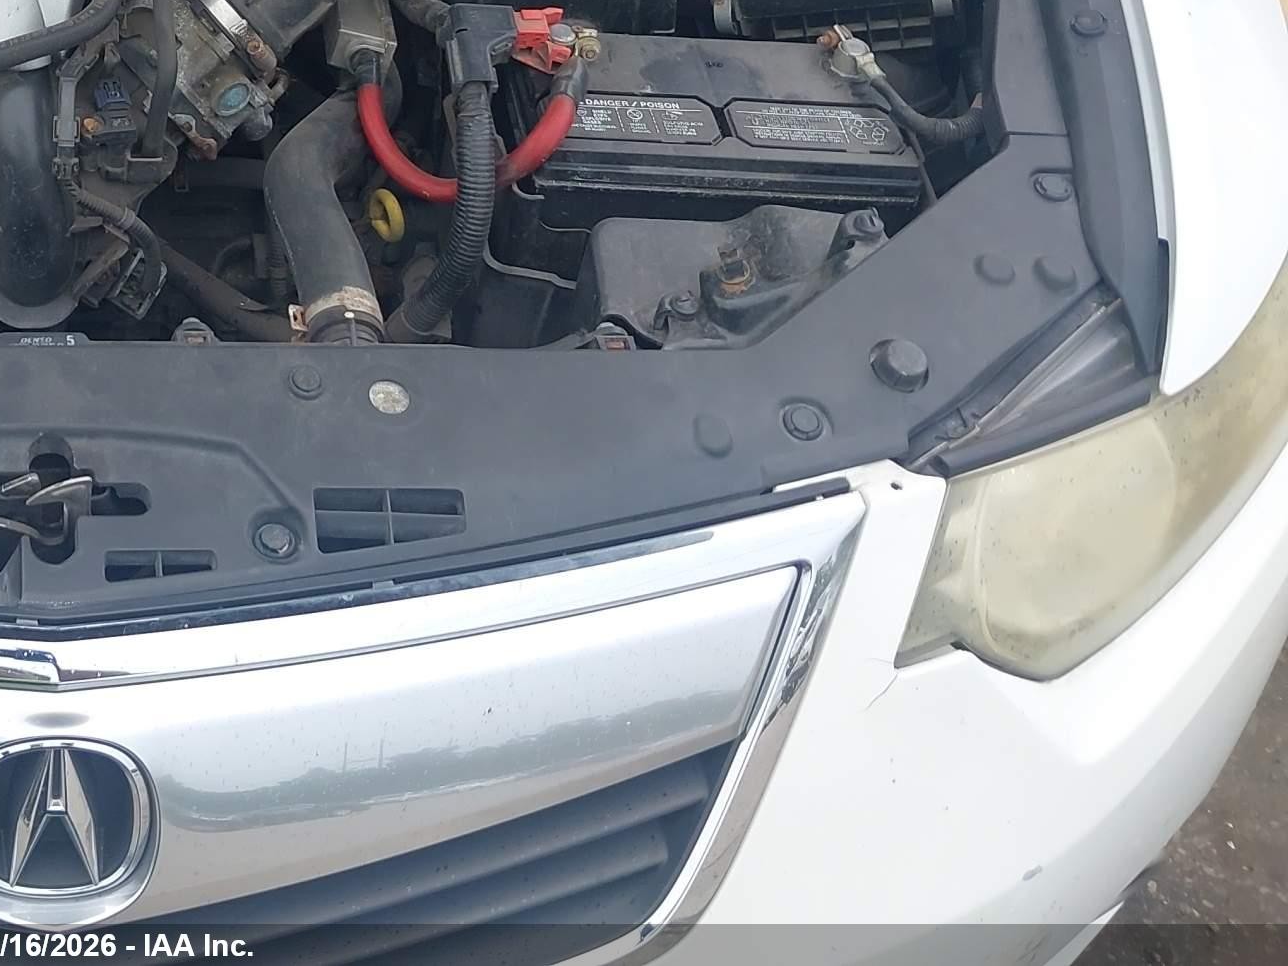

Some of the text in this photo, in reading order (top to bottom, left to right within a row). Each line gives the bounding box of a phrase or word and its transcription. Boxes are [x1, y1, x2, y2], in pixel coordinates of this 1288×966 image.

[585, 98, 629, 107] DANGER
[640, 101, 680, 109] POISON
[66, 335, 75, 345] 5
